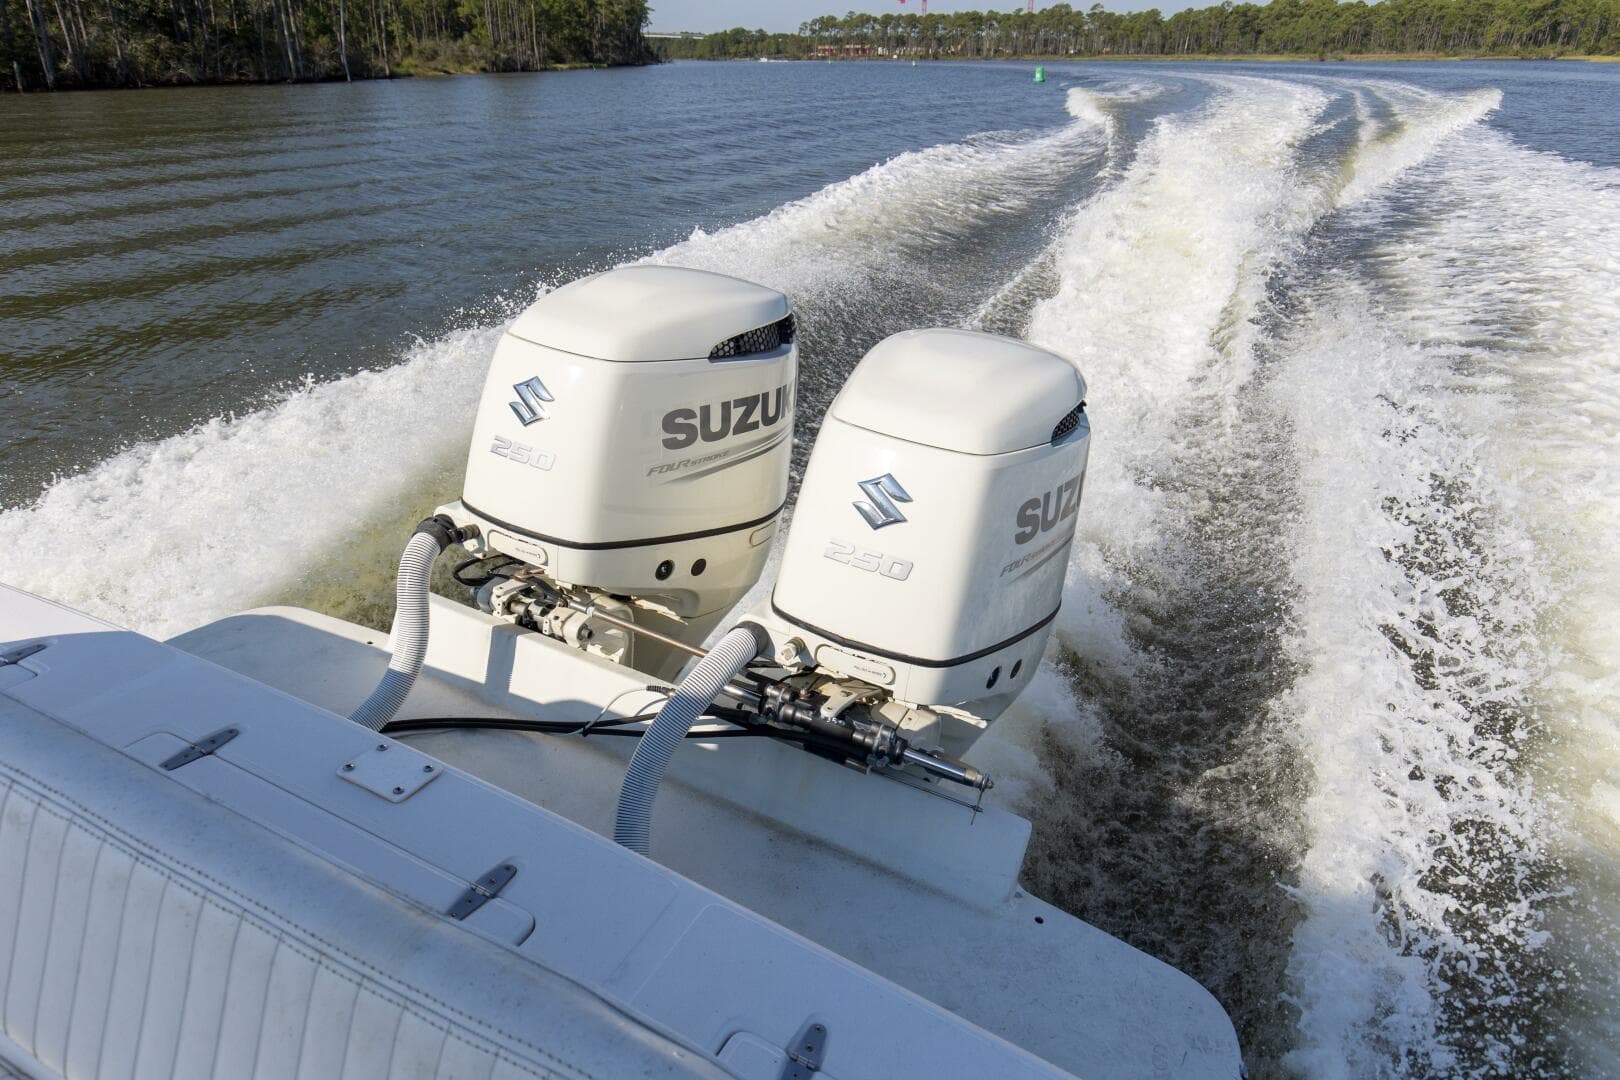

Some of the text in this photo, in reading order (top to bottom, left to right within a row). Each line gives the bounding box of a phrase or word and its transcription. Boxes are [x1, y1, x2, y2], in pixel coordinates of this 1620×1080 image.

[662, 383, 792, 450] SUZUK
[490, 434, 557, 471] 250
[1014, 470, 1085, 545] SUZ
[823, 537, 914, 581] 250
